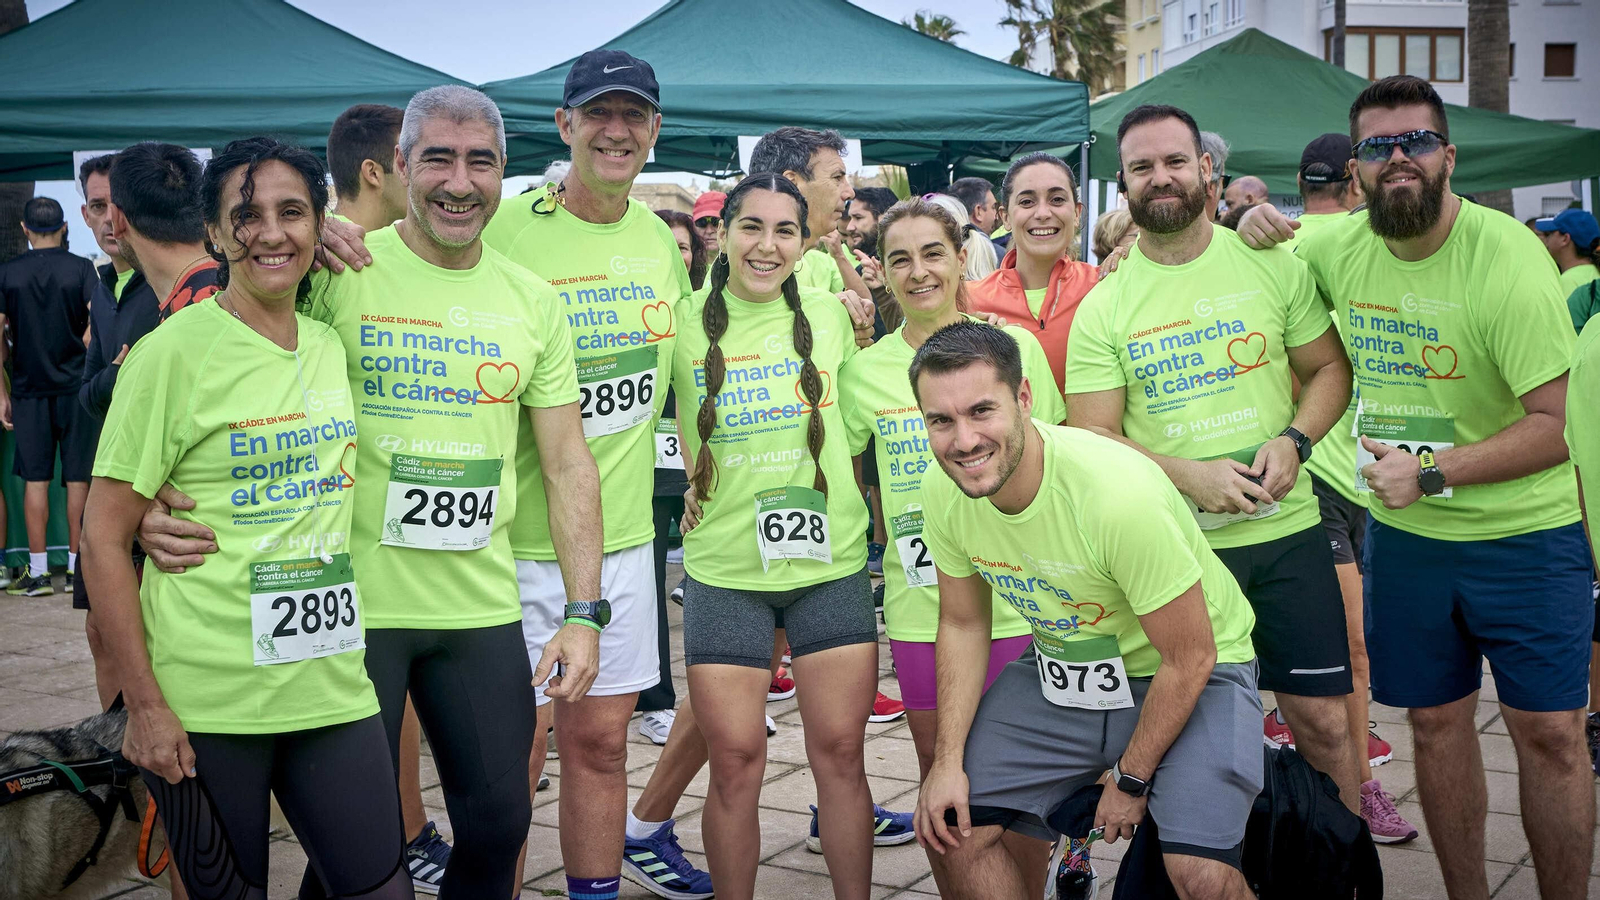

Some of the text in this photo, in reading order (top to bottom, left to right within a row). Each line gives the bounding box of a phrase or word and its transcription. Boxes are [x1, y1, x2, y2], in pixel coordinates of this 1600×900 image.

[558, 281, 656, 306] n marcha
[361, 314, 370, 322] IX
[370, 314, 396, 323] CÁDIZ
[410, 318, 443, 328] MARCHA
[1132, 328, 1152, 339] CÁDIZ
[1162, 319, 1192, 330] MARCHA
[1371, 316, 1439, 342] marcha
[360, 325, 502, 358] En marcha
[576, 329, 650, 350] cáncer
[1126, 318, 1246, 362] En marcha
[360, 353, 448, 378] contra
[592, 356, 617, 366] marcha
[594, 362, 618, 372] cáncer
[731, 354, 760, 362] MARCHA
[1134, 352, 1204, 381] contra
[1366, 356, 1430, 380] cáncer
[693, 368, 707, 388] E
[1144, 363, 1238, 399] el cáncer
[364, 376, 483, 406] el cáncer
[580, 374, 654, 418] 2896
[1168, 396, 1192, 405] ESPAÑOLA
[1192, 392, 1210, 400] CONTRA
[1217, 386, 1235, 394] CÁNCER
[228, 412, 307, 430] IX CÁDIZ EN MARCHA
[724, 400, 804, 428] cáncer
[1190, 406, 1258, 432] HYUNDAI
[230, 416, 356, 456] En marcha
[876, 418, 898, 436] En
[1192, 422, 1260, 442] Guadalete Motor
[411, 438, 487, 456] HYUNDAI
[664, 436, 682, 457] 3
[886, 435, 929, 456] contr
[230, 454, 320, 480] contra
[396, 456, 420, 466] Cádiz
[434, 462, 465, 470] marcha
[397, 466, 426, 474] contra
[437, 468, 465, 476] cáncer
[890, 458, 900, 476] el
[230, 474, 346, 506] el cáncer
[761, 489, 787, 498] marcha
[764, 494, 788, 504] cáncer
[270, 507, 301, 516] ESPAÑOLA
[400, 488, 494, 529] 2894
[897, 520, 918, 530] contra
[910, 538, 932, 568] 2
[254, 564, 280, 572] Cádiz
[258, 569, 324, 581] contra el cáncer
[995, 574, 1074, 602] marcha
[1000, 592, 1041, 612] ntra
[271, 588, 356, 638] 2893
[1036, 652, 1121, 693] 1973
[19, 774, 54, 786] Non-stop
